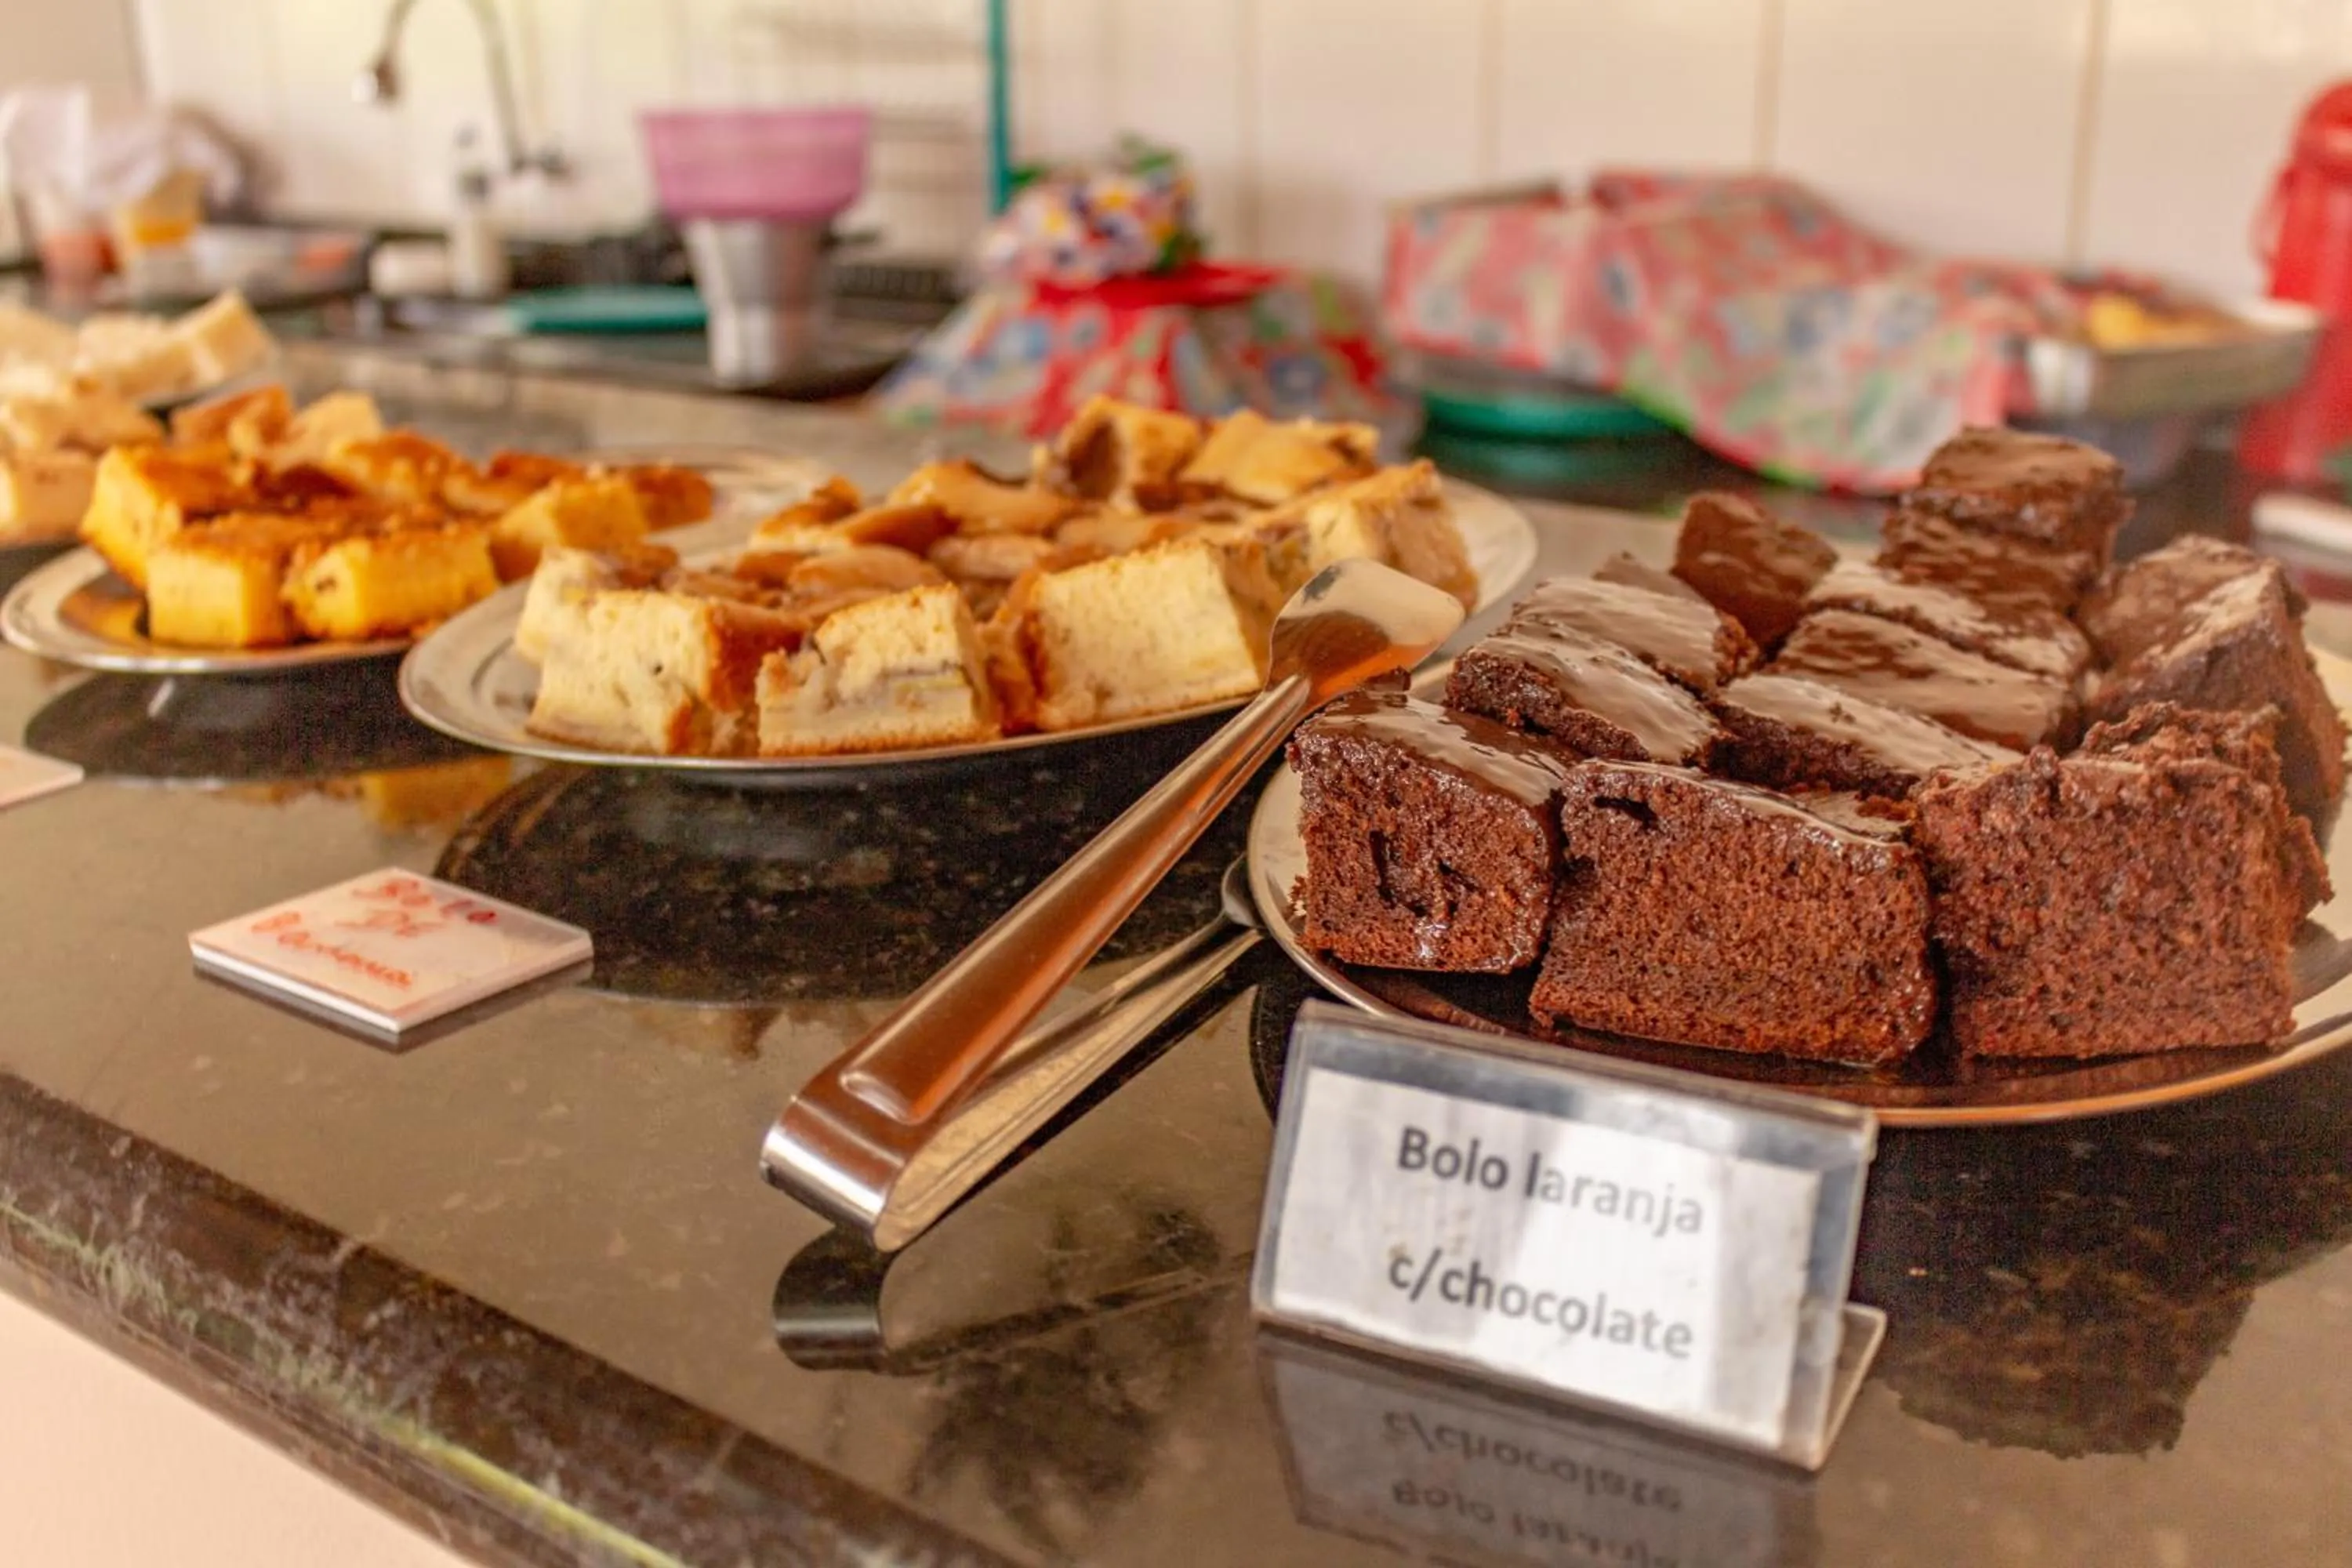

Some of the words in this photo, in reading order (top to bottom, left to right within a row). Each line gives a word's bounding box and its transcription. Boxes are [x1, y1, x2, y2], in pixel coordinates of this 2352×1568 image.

[1398, 1126, 1509, 1191] Bolo
[1523, 1150, 1704, 1239] laranja
[1388, 1248, 1694, 1359] c/chocolate
